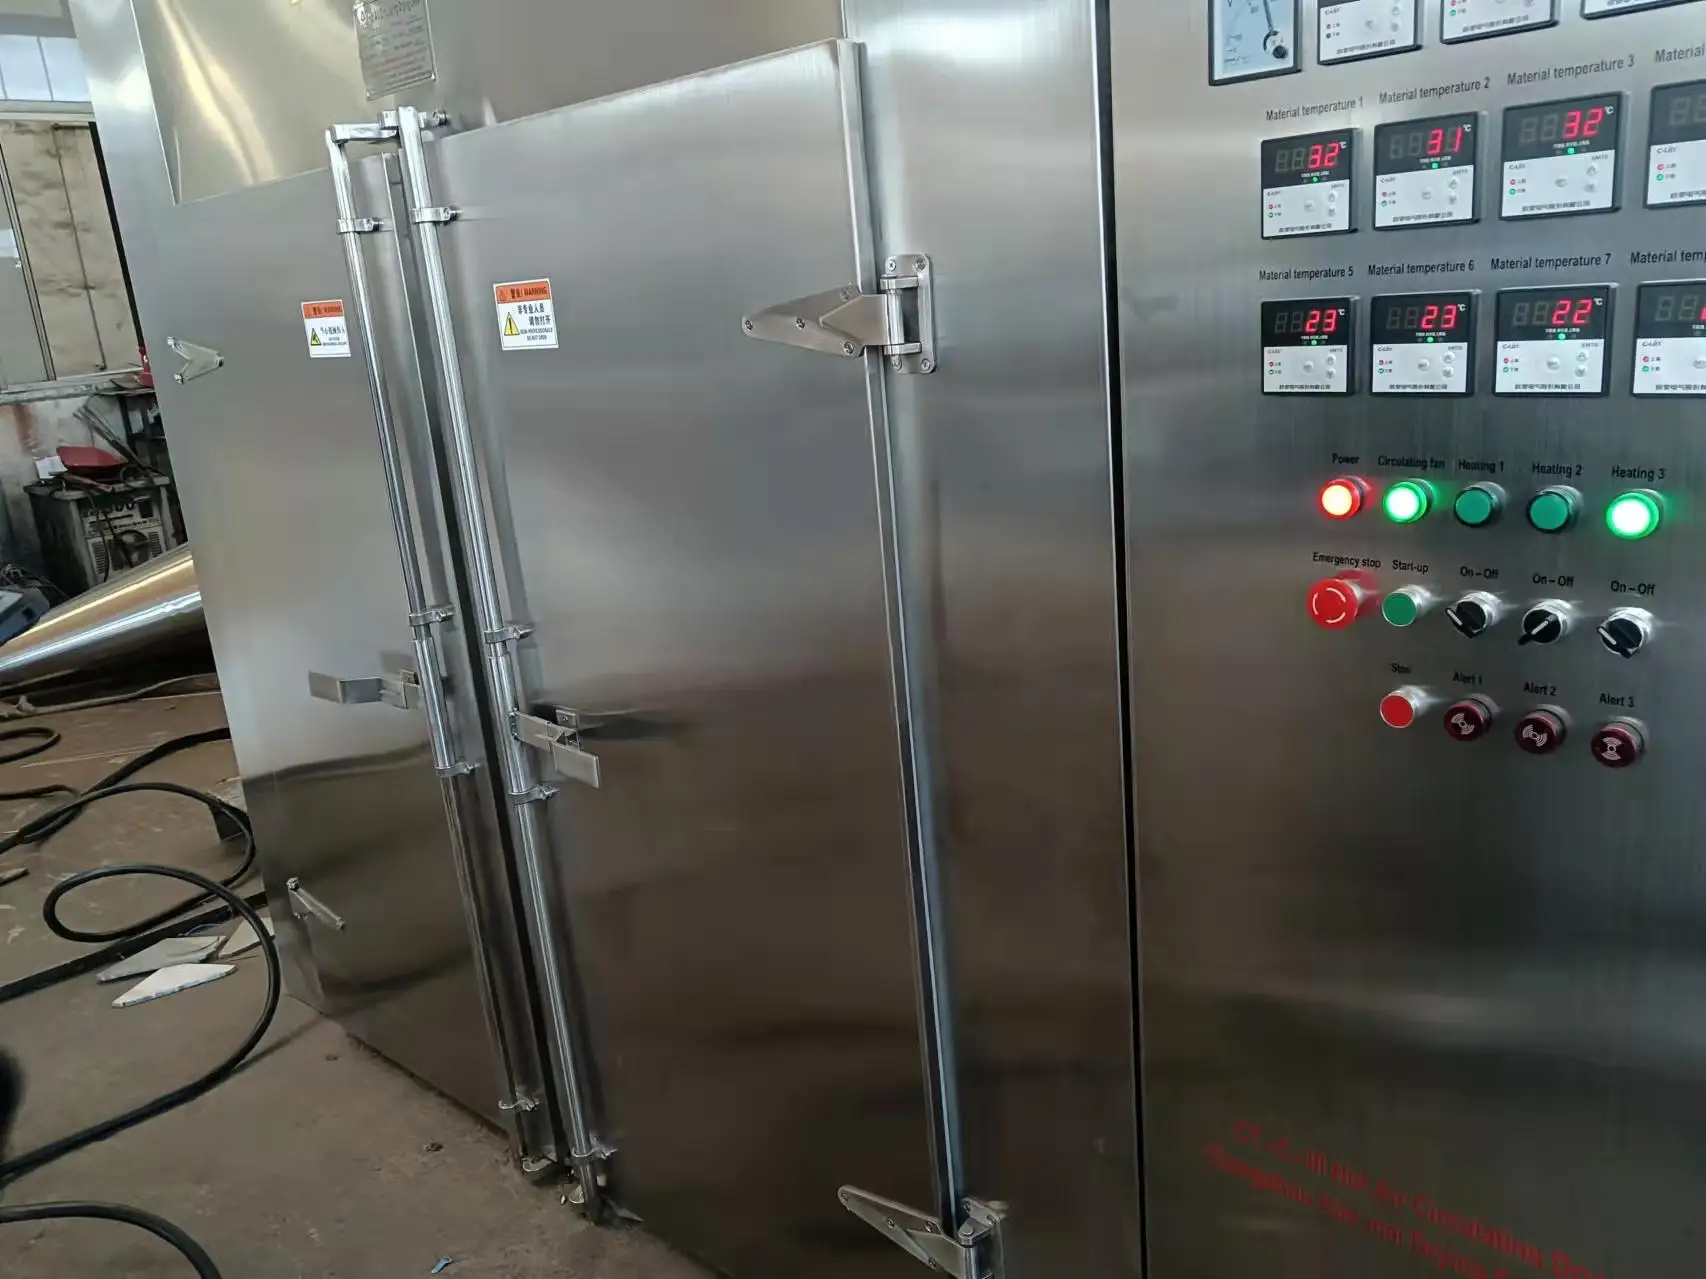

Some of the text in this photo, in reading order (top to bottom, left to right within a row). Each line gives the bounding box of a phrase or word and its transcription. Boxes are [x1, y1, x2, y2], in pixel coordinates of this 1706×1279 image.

[1655, 43, 1705, 63] Material
[1506, 54, 1635, 86] Material temperature 3
[1379, 76, 1491, 104] Material temperature 2
[1266, 96, 1363, 121] Material temperature 1
[1563, 107, 1604, 139] 32
[1427, 127, 1463, 155] 31
[1308, 142, 1340, 169] 32
[1491, 253, 1612, 271] Material temperature 7
[1630, 250, 1677, 265] Material
[1259, 266, 1354, 281] Material temperature 5
[1368, 260, 1475, 276] Material temperature 6
[1421, 304, 1457, 329] 23
[1552, 299, 1593, 325] 22
[1305, 309, 1337, 333] 23
[1332, 453, 1360, 464] Power
[1378, 455, 1446, 472] Circulating fan
[1458, 459, 1504, 474] Heating 1
[1532, 461, 1583, 478] Heating 2
[1612, 465, 1666, 481] Heating 3
[1312, 552, 1382, 570] Emergency stop
[1392, 560, 1429, 574] Start-up
[1452, 671, 1477, 685] Alert
[1523, 682, 1557, 696] Alert 2
[1599, 693, 1635, 708] Alert 3
